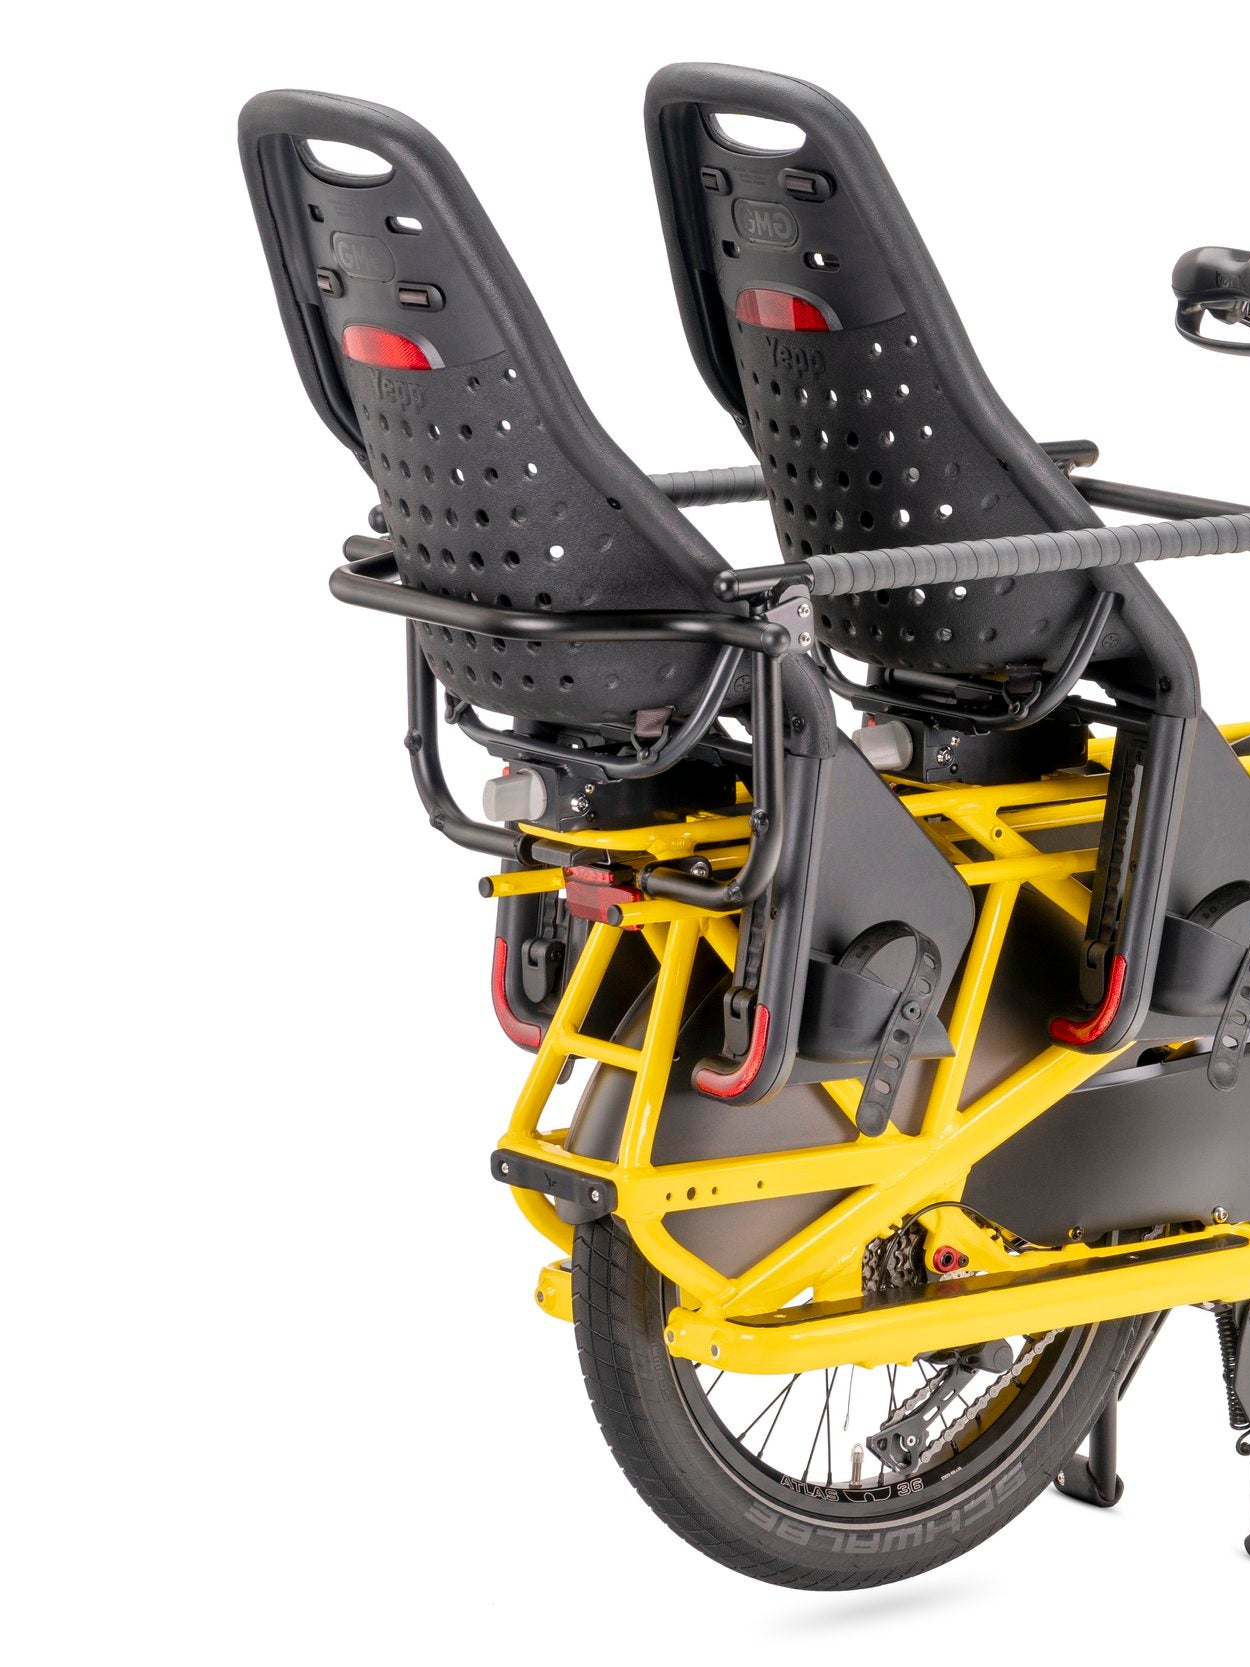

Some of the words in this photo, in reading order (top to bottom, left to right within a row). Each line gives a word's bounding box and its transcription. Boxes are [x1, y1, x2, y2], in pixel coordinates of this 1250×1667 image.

[761, 334, 826, 379] Yepp
[367, 366, 426, 415] Yepp
[743, 1461, 1027, 1554] SCHWALBE
[780, 1474, 840, 1502] ATLAS
[897, 1477, 925, 1497] 36
